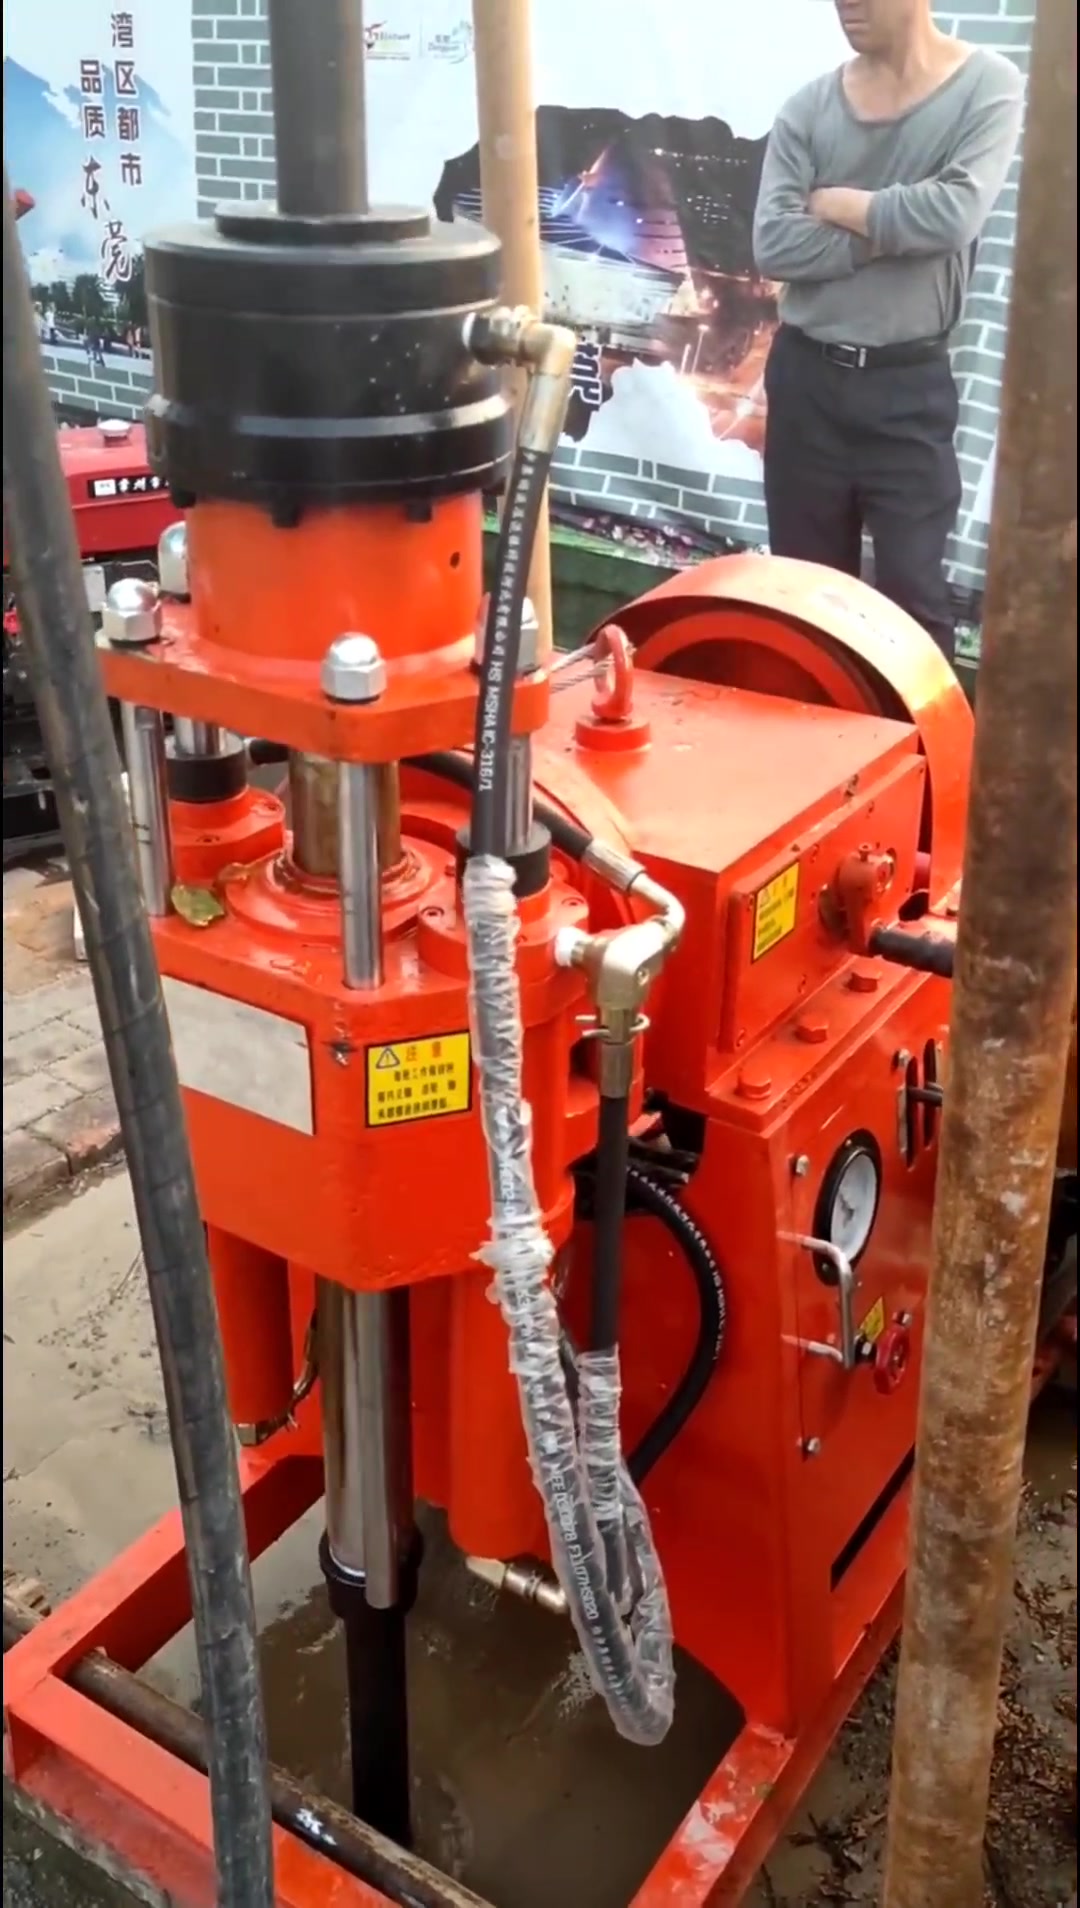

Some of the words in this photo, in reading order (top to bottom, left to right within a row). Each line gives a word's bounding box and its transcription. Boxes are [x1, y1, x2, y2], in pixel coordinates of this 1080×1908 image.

[80, 59, 131, 280] 品质东莞
[111, 12, 142, 186] 湾区都市
